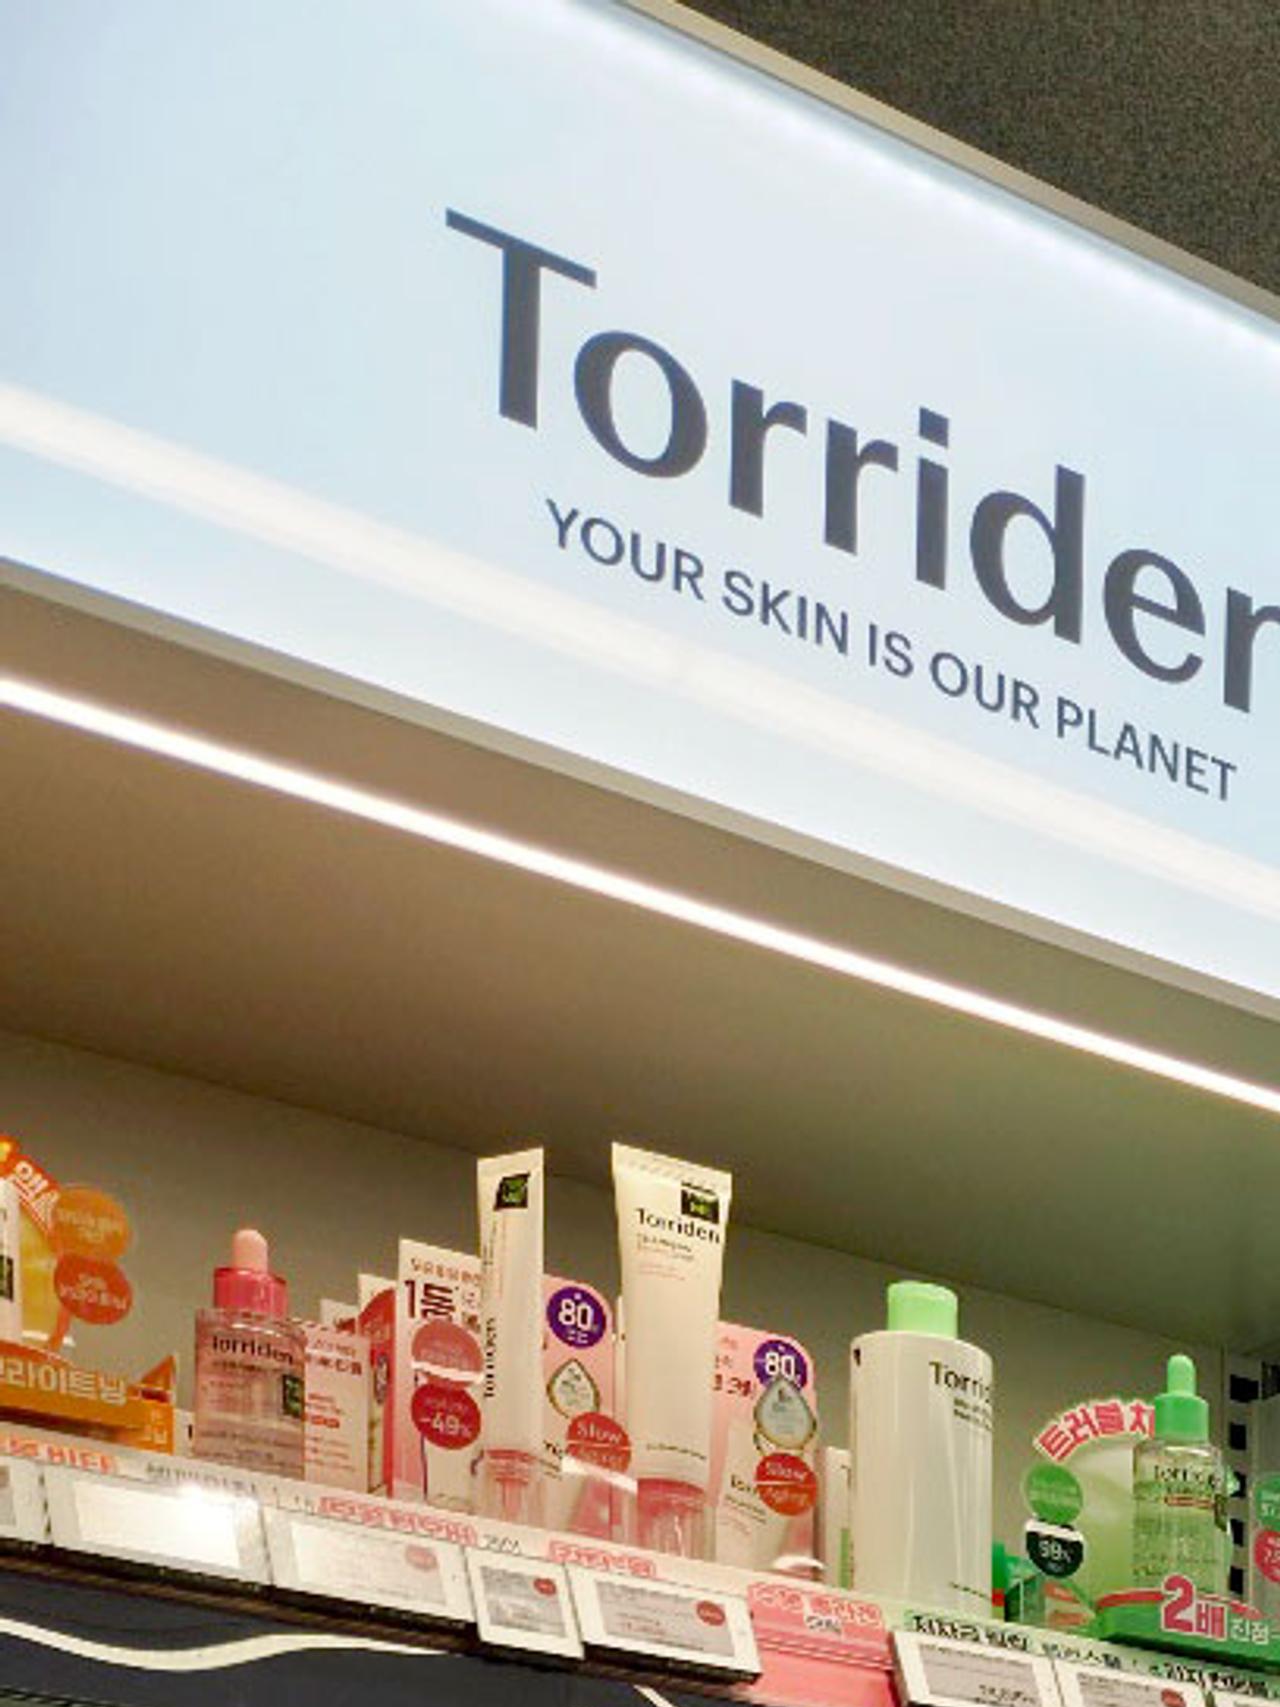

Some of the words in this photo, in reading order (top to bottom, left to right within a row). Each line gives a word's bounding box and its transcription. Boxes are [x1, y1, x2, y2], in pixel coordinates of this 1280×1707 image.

[545, 499, 706, 602] YOUR
[721, 567, 850, 657] SKIN
[866, 619, 915, 679] IS
[929, 650, 1042, 731] OUR
[1055, 695, 1238, 803] PLANET
[1161, 1574, 1227, 1641] 2배
